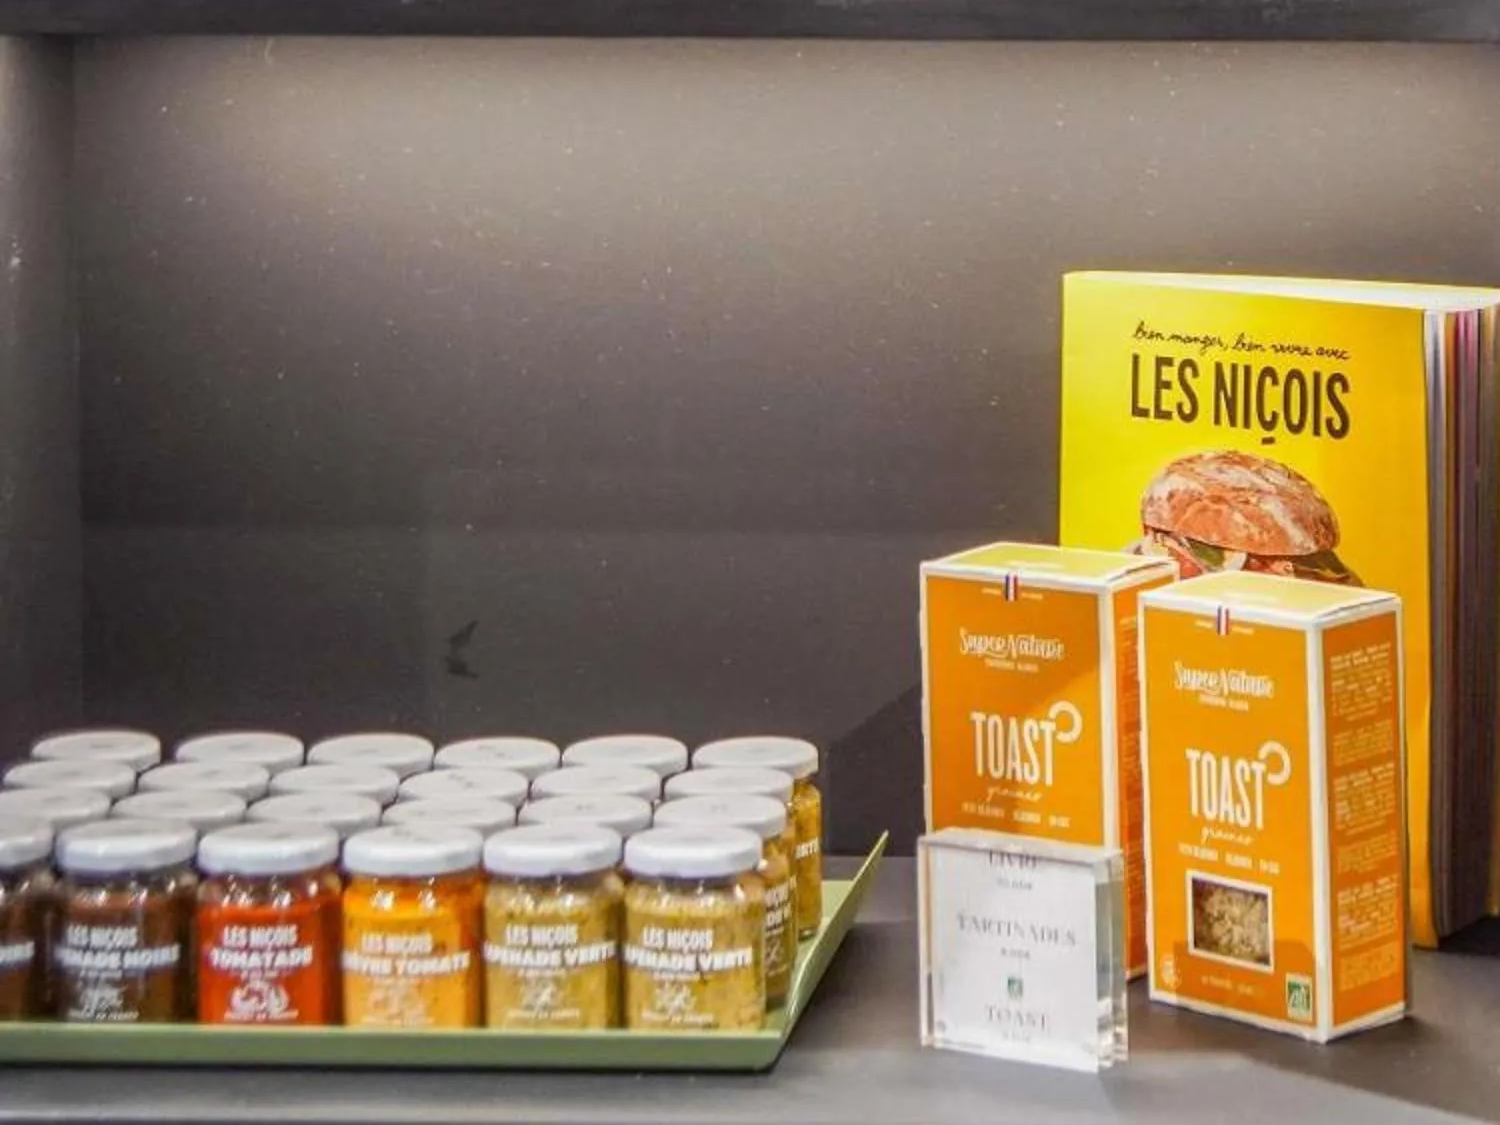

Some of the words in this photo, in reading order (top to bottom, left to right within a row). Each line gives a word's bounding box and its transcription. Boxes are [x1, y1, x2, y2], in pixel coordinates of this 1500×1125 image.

[1131, 353, 1199, 424] LES
[1213, 361, 1351, 446] NIÇOIS
[969, 709, 1057, 787] TOAST
[1185, 746, 1267, 831] TOAST
[223, 924, 248, 946] LES
[505, 922, 530, 946] LES
[642, 925, 665, 948] LES
[956, 910, 1077, 946] TARTINADES
